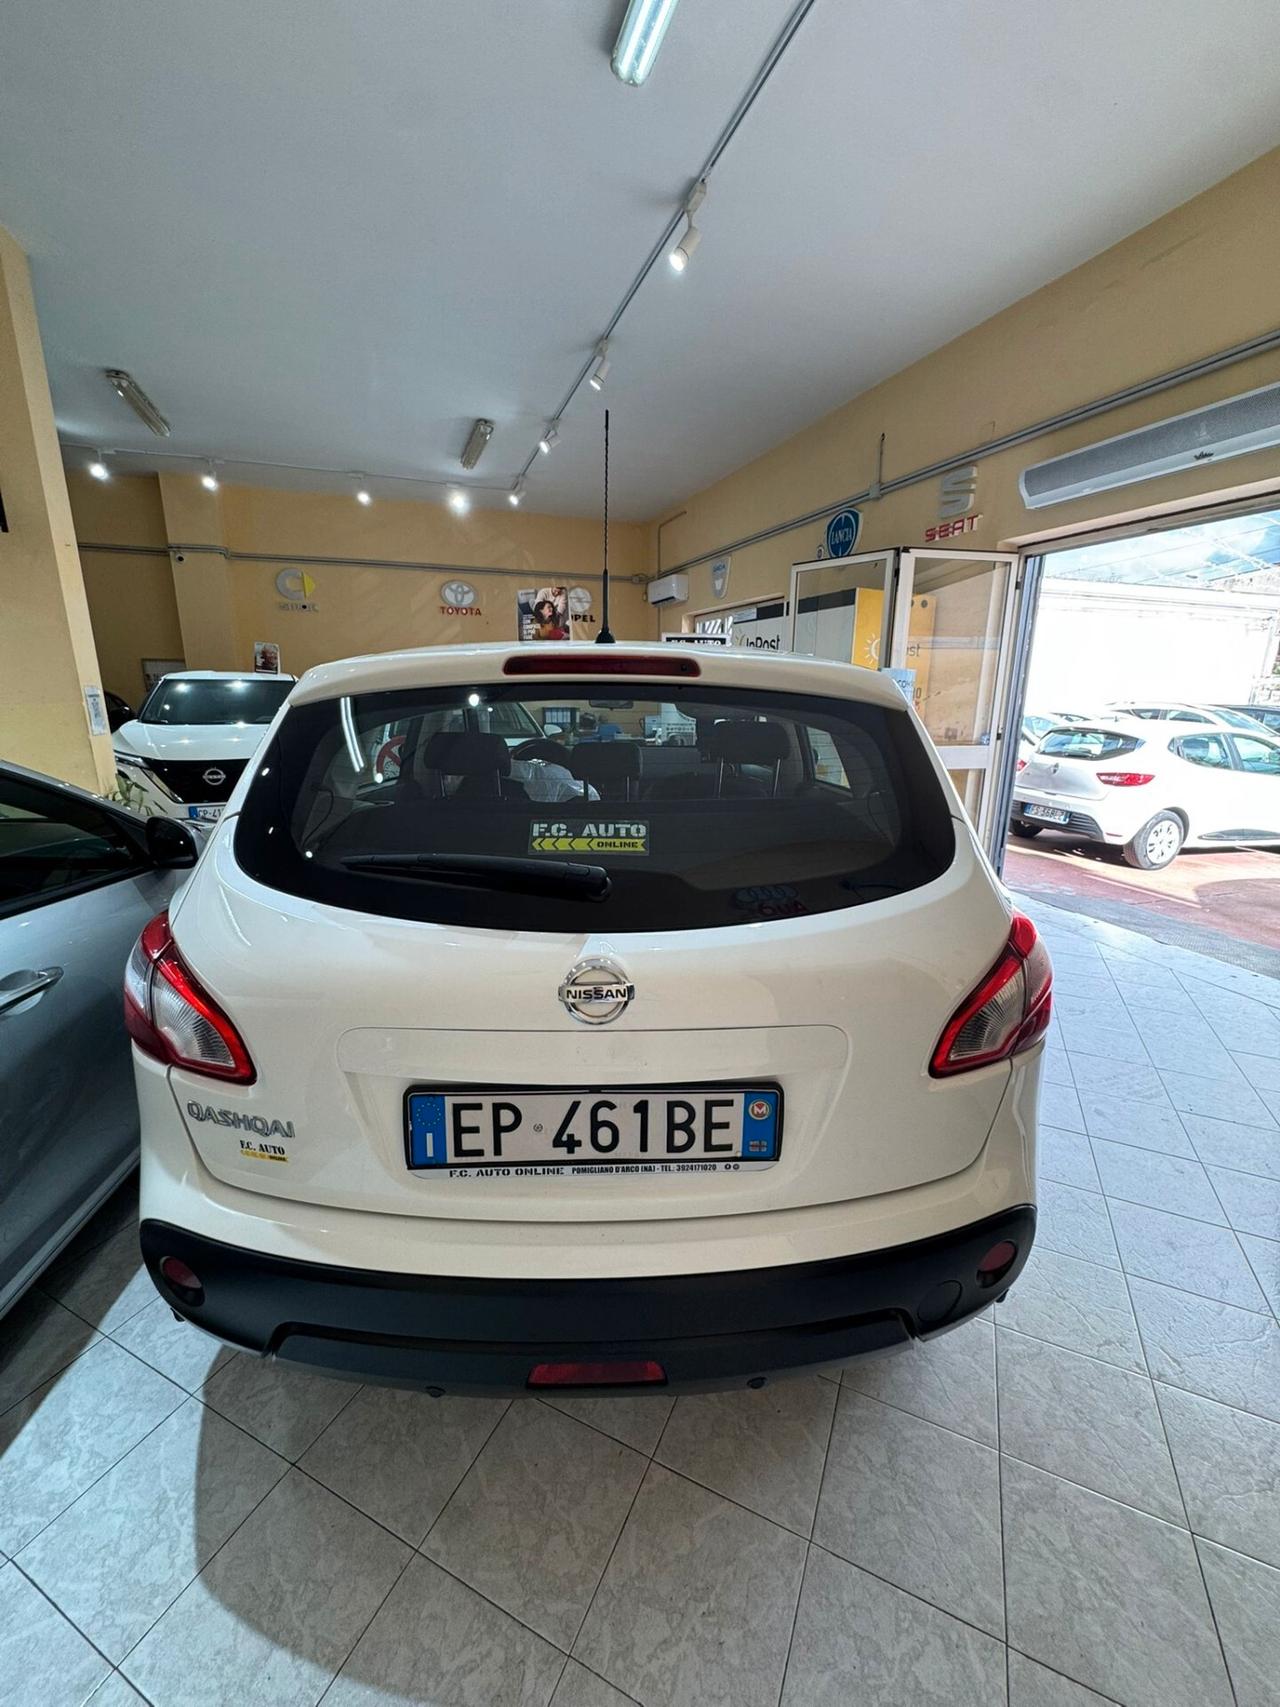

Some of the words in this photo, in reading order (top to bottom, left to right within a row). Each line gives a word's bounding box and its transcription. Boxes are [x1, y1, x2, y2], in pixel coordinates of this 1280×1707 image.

[925, 514, 979, 543] SEAT
[440, 606, 482, 617] TOYOTA
[533, 823, 573, 837] F.C.
[582, 823, 646, 837] AUTO
[567, 988, 626, 999] NISSAN
[187, 1101, 295, 1138] QASHQAI
[452, 1102, 522, 1157] EP
[552, 1099, 734, 1154] 461BE
[259, 1143, 285, 1155] AUTO
[426, 1133, 434, 1157] I
[449, 1169, 471, 1178] F.C.
[476, 1168, 510, 1177] AUTO
[515, 1167, 564, 1176] ONLINE
[572, 1166, 613, 1174] POMIGLIANO
[615, 1165, 639, 1173] D'ARCO
